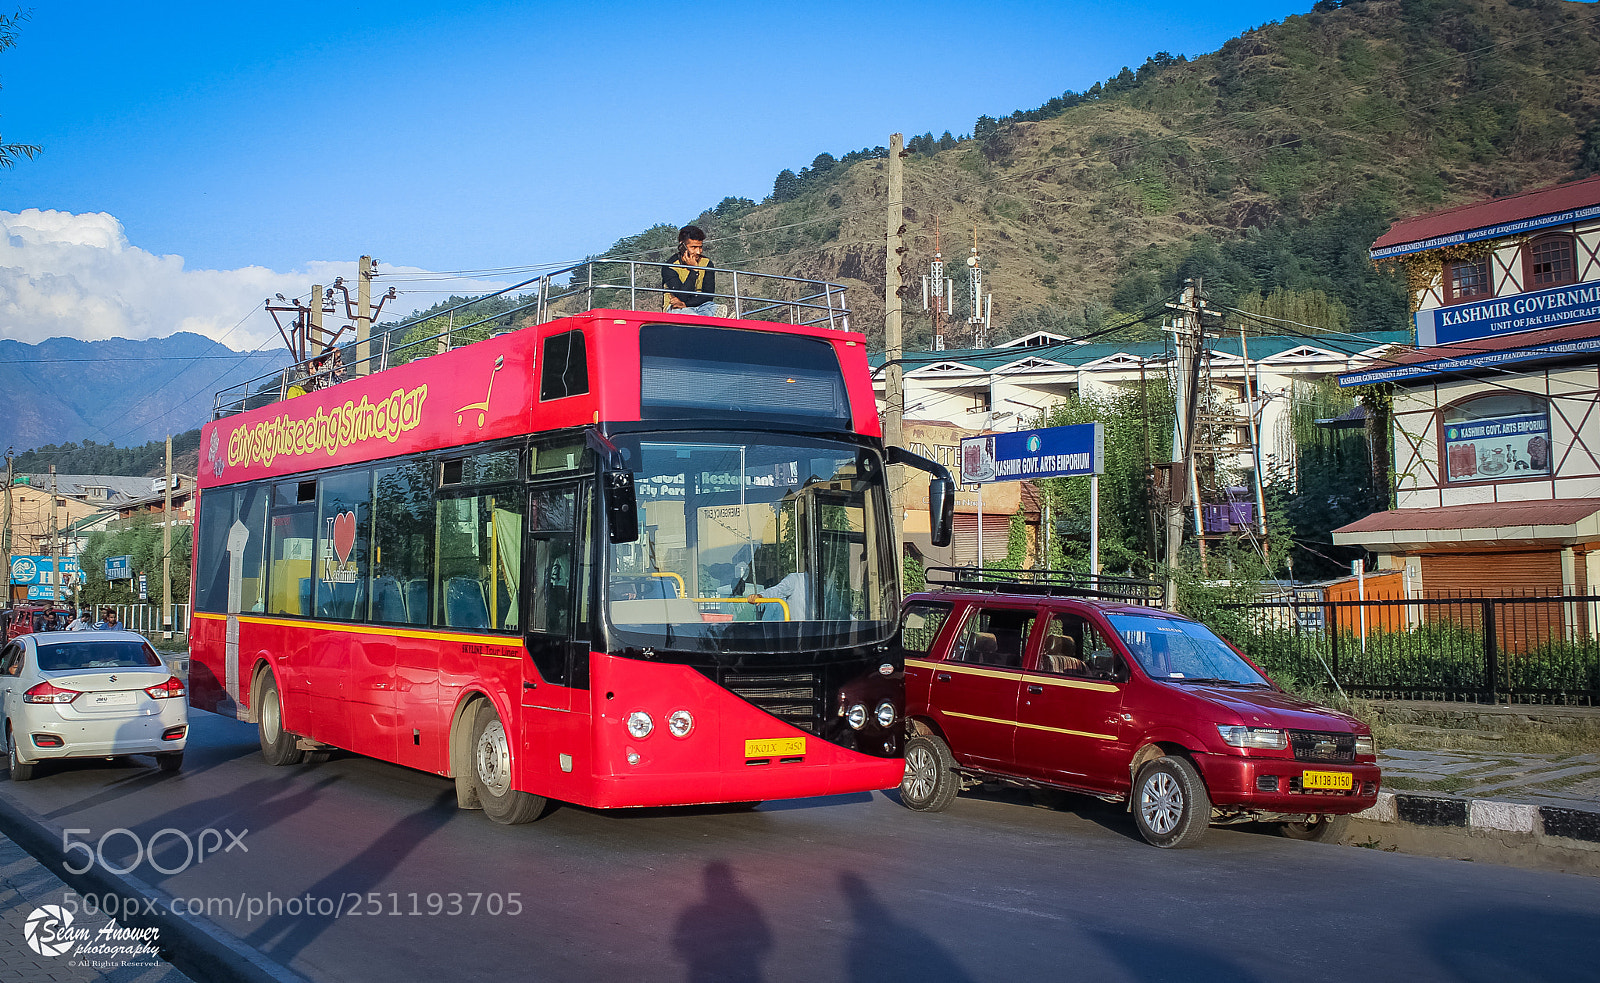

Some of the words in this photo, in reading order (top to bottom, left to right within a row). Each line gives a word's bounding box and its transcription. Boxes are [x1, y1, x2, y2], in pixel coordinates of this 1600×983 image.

[1370, 247, 1392, 258] KASHMIR
[1392, 242, 1425, 254] GOVERNMENT
[1425, 238, 1436, 248] ARTS
[1438, 233, 1464, 246] EMPORIUM
[1467, 230, 1487, 240] HOUSE
[1496, 222, 1528, 234] EXQUISITE
[1529, 212, 1573, 227] HANDICRAFTS
[1442, 302, 1511, 326] KASHMIR
[1490, 320, 1512, 332] UNIT
[1514, 318, 1525, 328] OF
[1526, 316, 1543, 326] J&K
[1340, 376, 1362, 385] KASHMIR
[1362, 370, 1396, 382] GOVERNMENT
[1549, 343, 1576, 352] KASHMIR
[1460, 426, 1484, 438] KASHMIR
[1486, 424, 1501, 436] GOVT.
[1502, 422, 1516, 434] ARTS
[995, 458, 1021, 476] KASHMIR
[1022, 457, 1040, 474] GOVT.
[1040, 455, 1056, 472] ARTS
[1056, 452, 1090, 471] EMPORIUM
[322, 556, 356, 584] Kashmir
[486, 646, 500, 656] Tour
[502, 647, 518, 658] Liner
